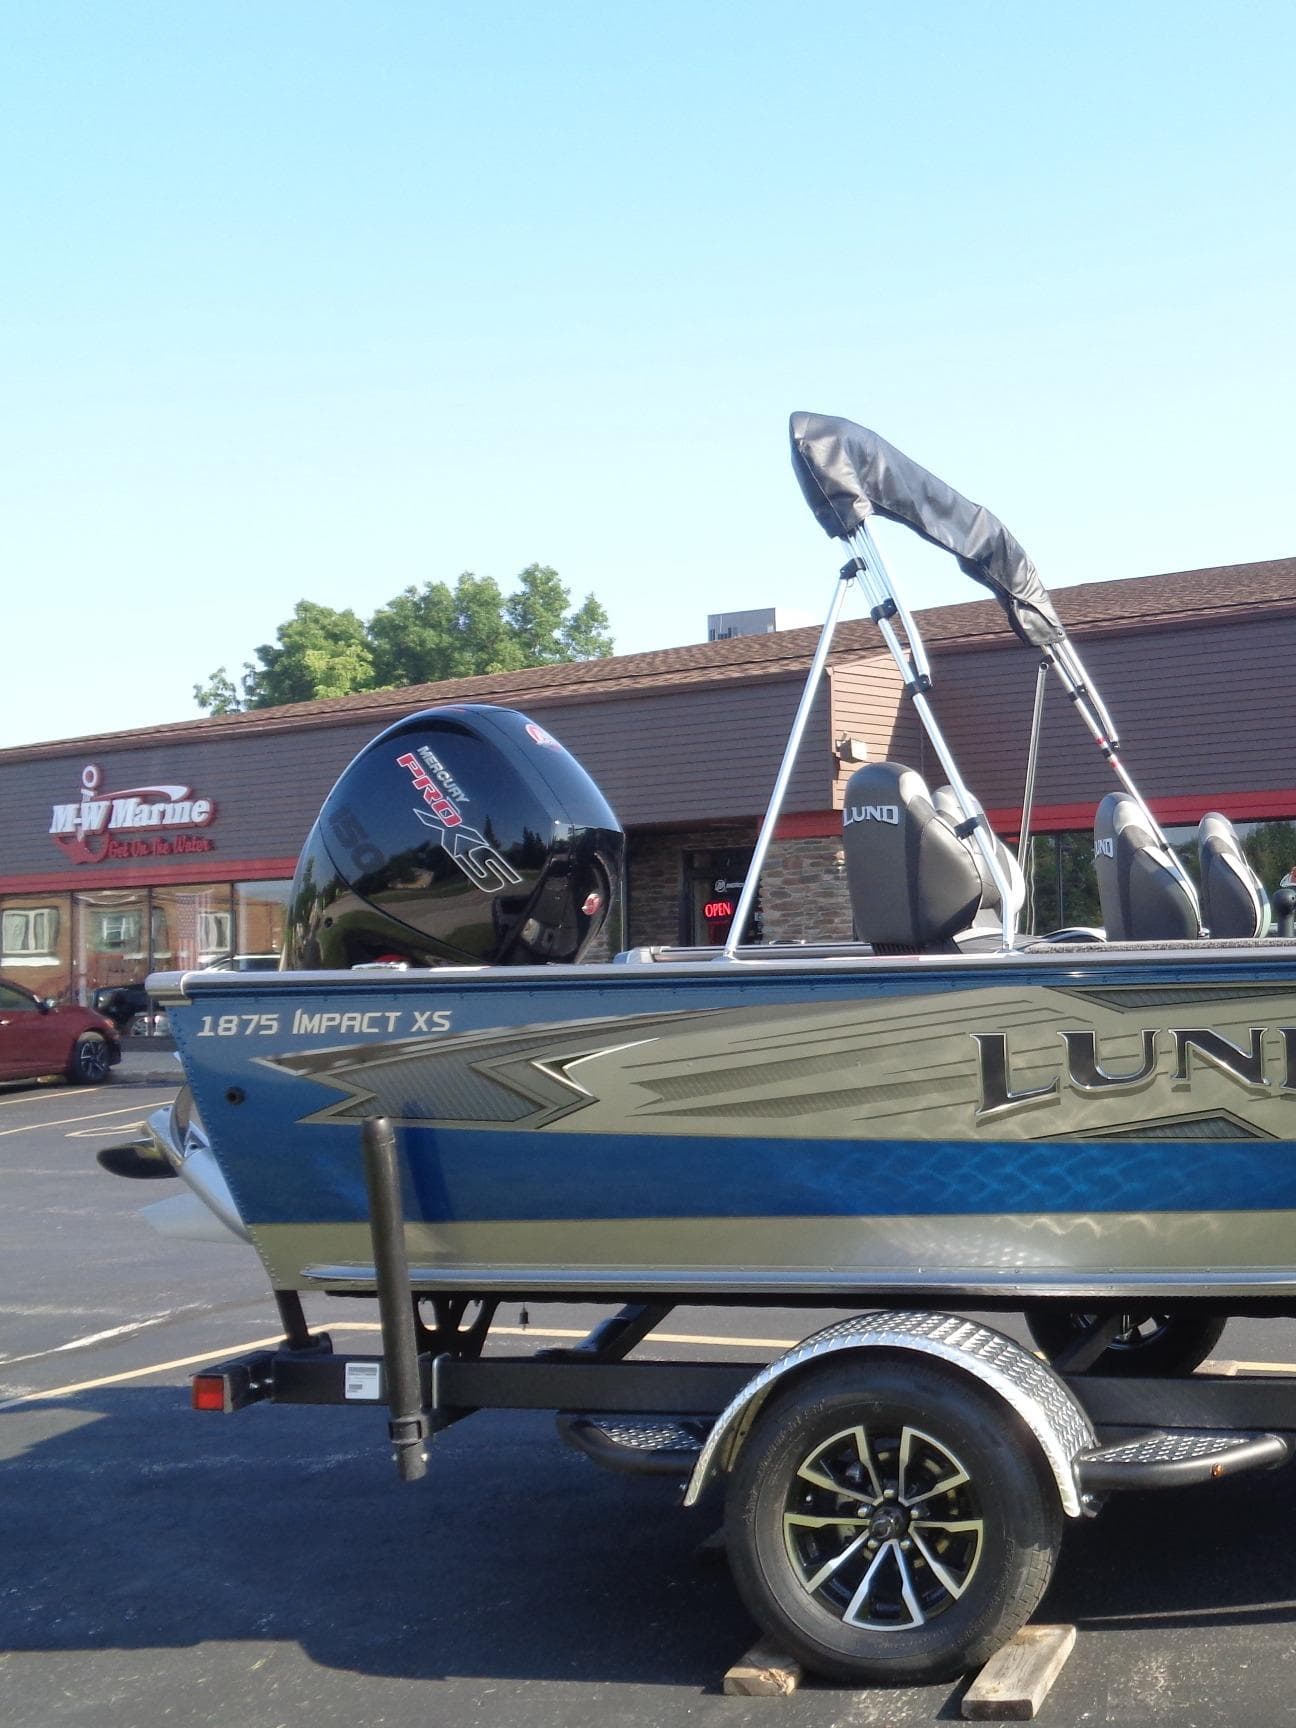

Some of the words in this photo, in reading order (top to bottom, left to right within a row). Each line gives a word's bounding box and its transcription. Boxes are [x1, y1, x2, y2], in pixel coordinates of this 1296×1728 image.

[396, 752, 462, 828] PRO
[416, 745, 470, 803] MERCURY
[49, 800, 111, 834] M-W
[108, 797, 211, 829] Marine
[843, 805, 899, 827] LUND
[110, 840, 130, 858] Get
[132, 840, 150, 857] On
[152, 837, 174, 855] The
[174, 834, 209, 853] Water
[413, 808, 523, 893] XS
[704, 902, 731, 918] OPEN
[197, 1013, 279, 1037] 1875
[292, 1009, 402, 1035] IMPACT
[410, 1010, 453, 1033] XS
